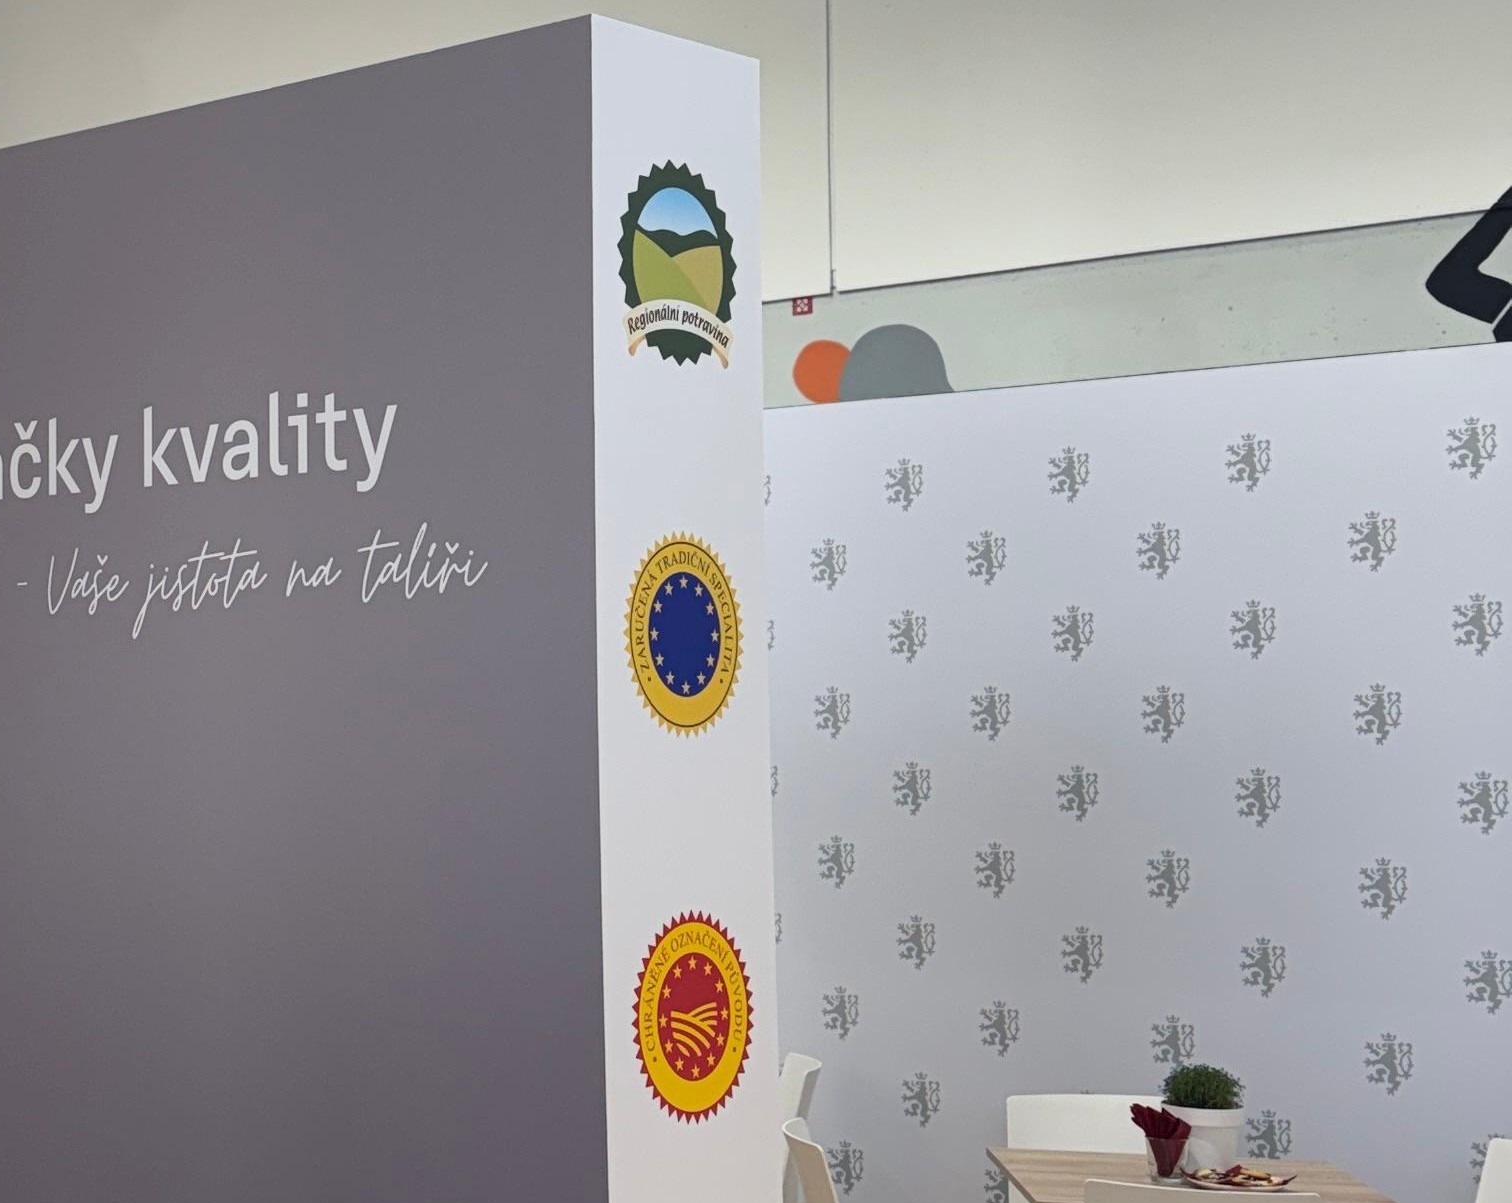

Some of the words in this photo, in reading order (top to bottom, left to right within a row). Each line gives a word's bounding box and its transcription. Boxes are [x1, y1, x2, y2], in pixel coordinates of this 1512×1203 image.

[627, 303, 680, 336] Regionální
[682, 309, 730, 348] potravina
[143, 391, 397, 492] kvality
[47, 547, 129, 615] Vaše
[132, 538, 268, 640] jistota
[286, 556, 341, 597] na
[357, 522, 488, 603] talíři
[635, 569, 658, 673] ZARUČENÁ
[656, 550, 711, 577] TRADIČNÍ
[709, 572, 734, 678] SPECIALITA
[670, 930, 729, 964] OZNAČENÍ
